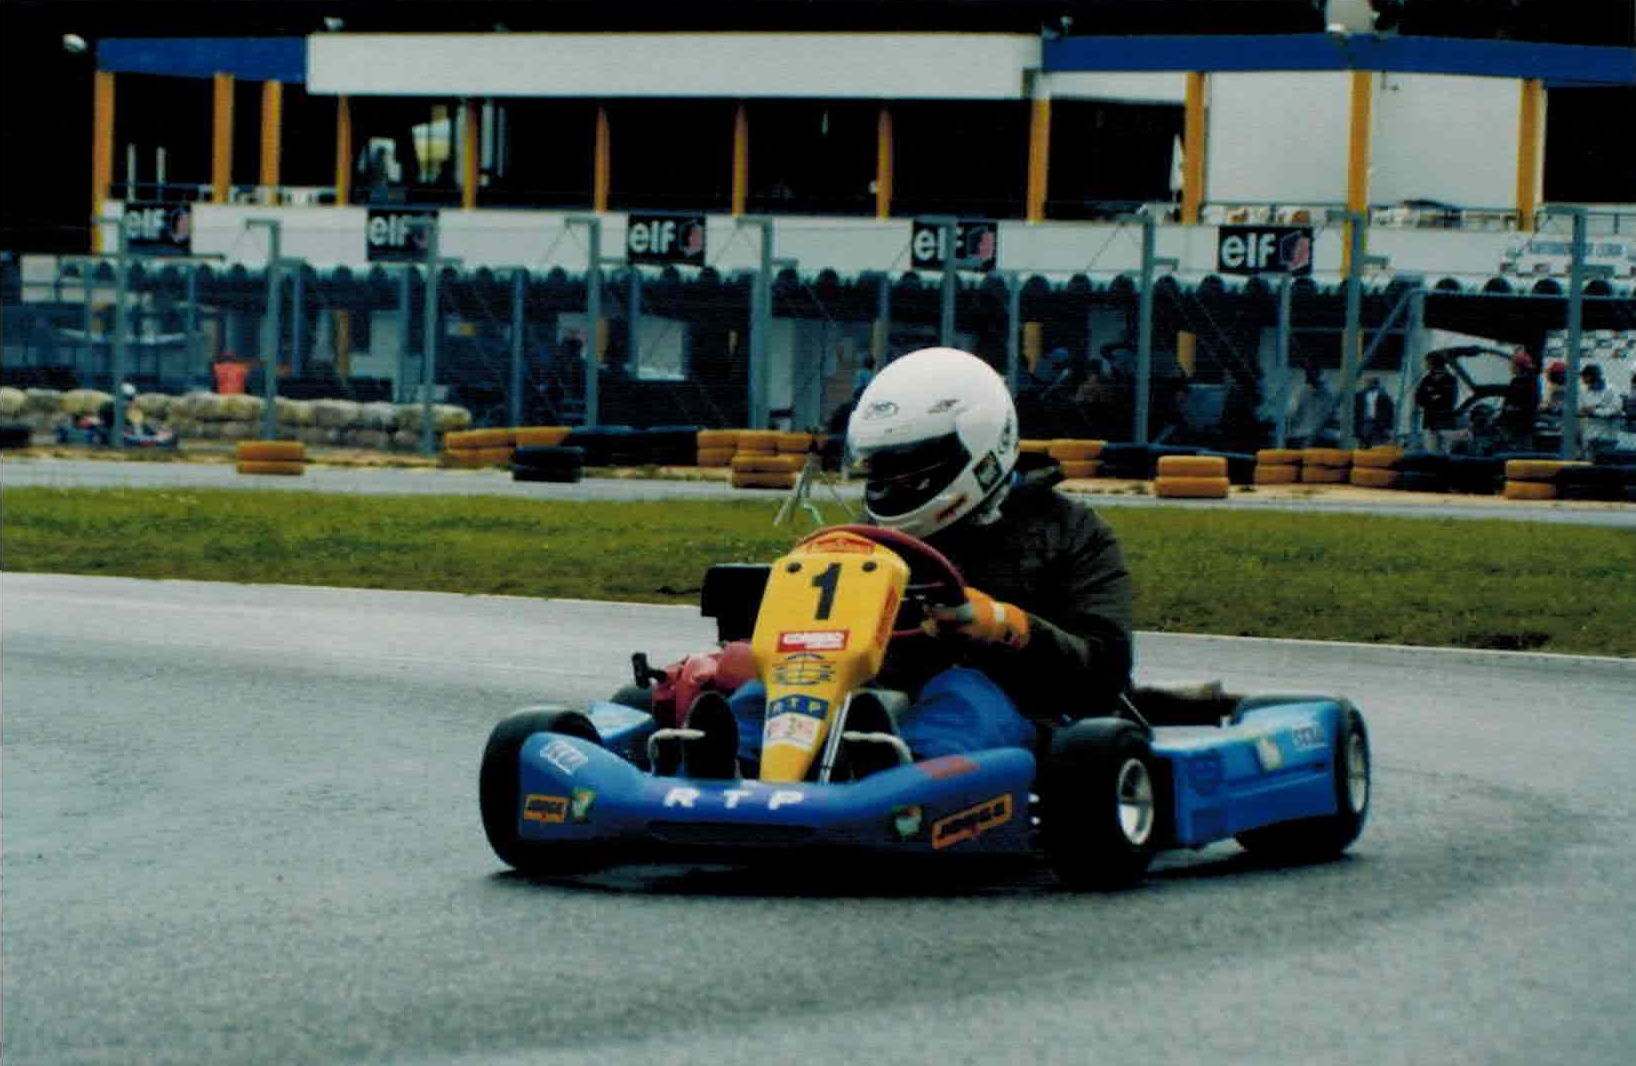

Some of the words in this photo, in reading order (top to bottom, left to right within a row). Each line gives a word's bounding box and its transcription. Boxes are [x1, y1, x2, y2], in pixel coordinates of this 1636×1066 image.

[124, 208, 165, 239] elf
[371, 213, 412, 246] elf
[629, 221, 676, 254] elf
[1220, 231, 1277, 268] elf
[811, 562, 844, 621] 1
